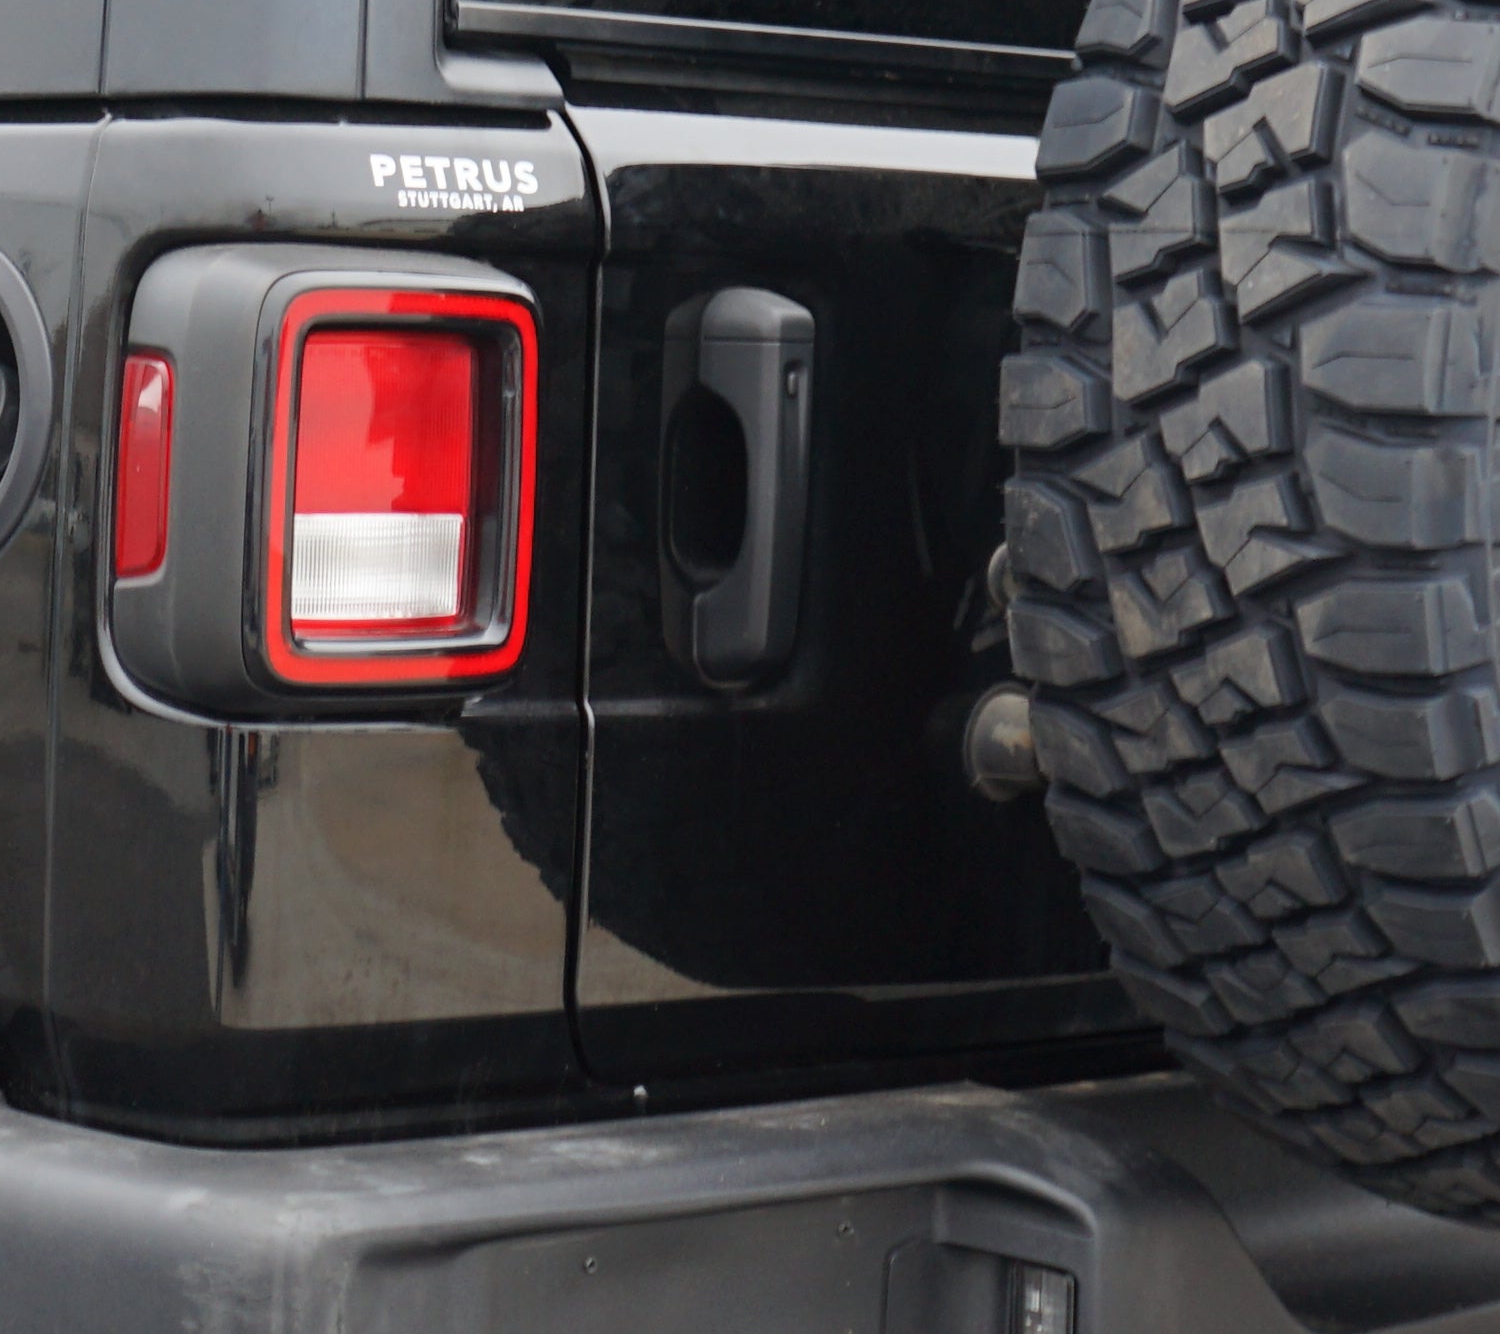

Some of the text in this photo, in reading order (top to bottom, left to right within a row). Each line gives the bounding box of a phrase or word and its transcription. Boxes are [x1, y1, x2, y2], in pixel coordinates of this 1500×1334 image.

[369, 153, 539, 194] PETRUS
[397, 189, 525, 214] STUTTGART, AR
